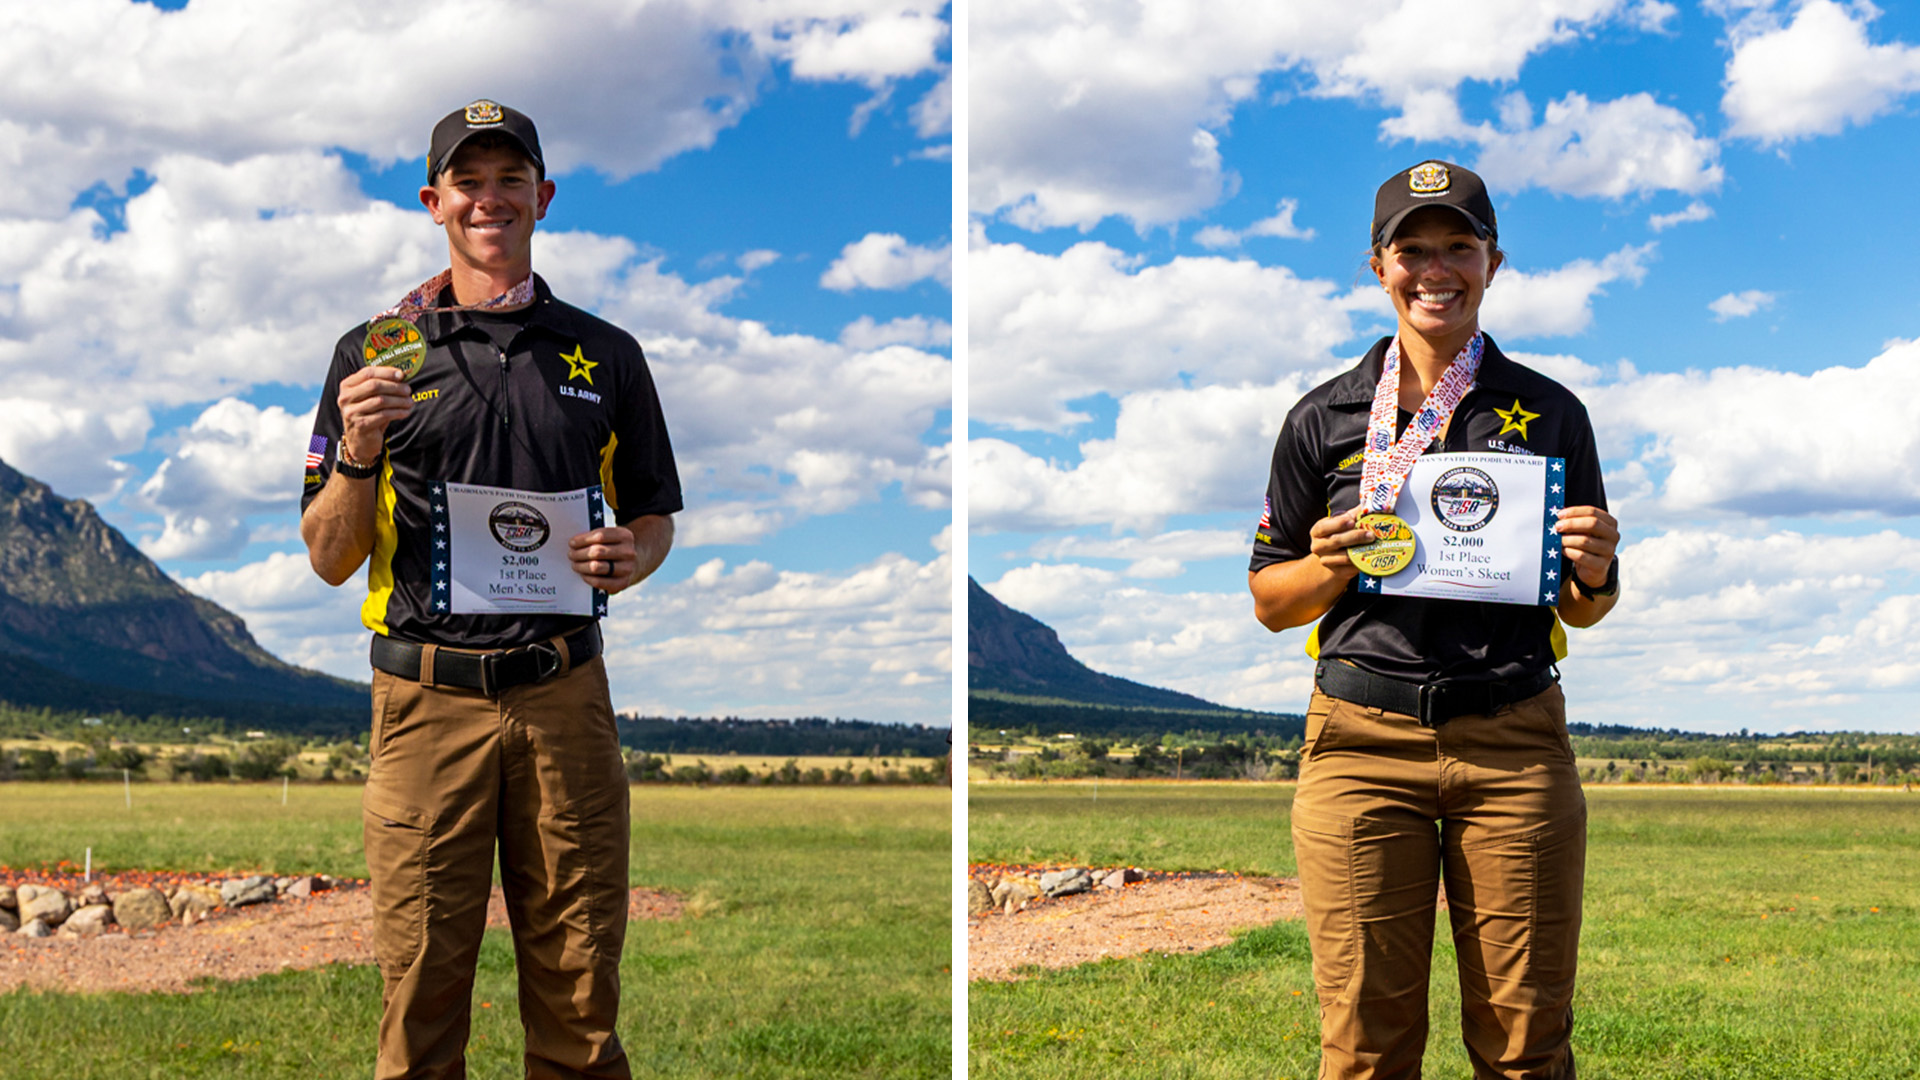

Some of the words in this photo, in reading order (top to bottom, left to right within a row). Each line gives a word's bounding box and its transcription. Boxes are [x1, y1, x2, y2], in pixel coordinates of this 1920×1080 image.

[1436, 382, 1452, 401] 2026
[1448, 363, 1465, 383] FALL
[1443, 369, 1471, 408] SELECTION
[411, 389, 439, 402] LIOTT
[560, 385, 577, 397] U.S.
[577, 389, 601, 404] ARMY
[1420, 408, 1436, 430] USA
[1376, 432, 1388, 451] USA
[1488, 440, 1506, 451] U.S.
[1338, 452, 1364, 470] SIMON
[1386, 455, 1402, 472] 2026
[1397, 438, 1415, 455] FALL
[1394, 439, 1425, 475] SELECTION
[1514, 458, 1543, 466] AWARD
[449, 487, 495, 496] CHAIRMAN'S
[557, 494, 584, 502] AWARD
[1373, 484, 1390, 509] USA
[1443, 535, 1484, 547] $2,000
[502, 555, 539, 566] $2,000
[1374, 555, 1396, 567] USA
[1440, 550, 1455, 561] 1st
[1459, 551, 1491, 563] Place
[500, 569, 514, 579] 1st
[517, 569, 547, 580] Place
[1417, 563, 1474, 577] Women's
[1478, 567, 1511, 580] Skeet
[489, 584, 524, 594] Men's
[526, 584, 557, 595] Skeet
